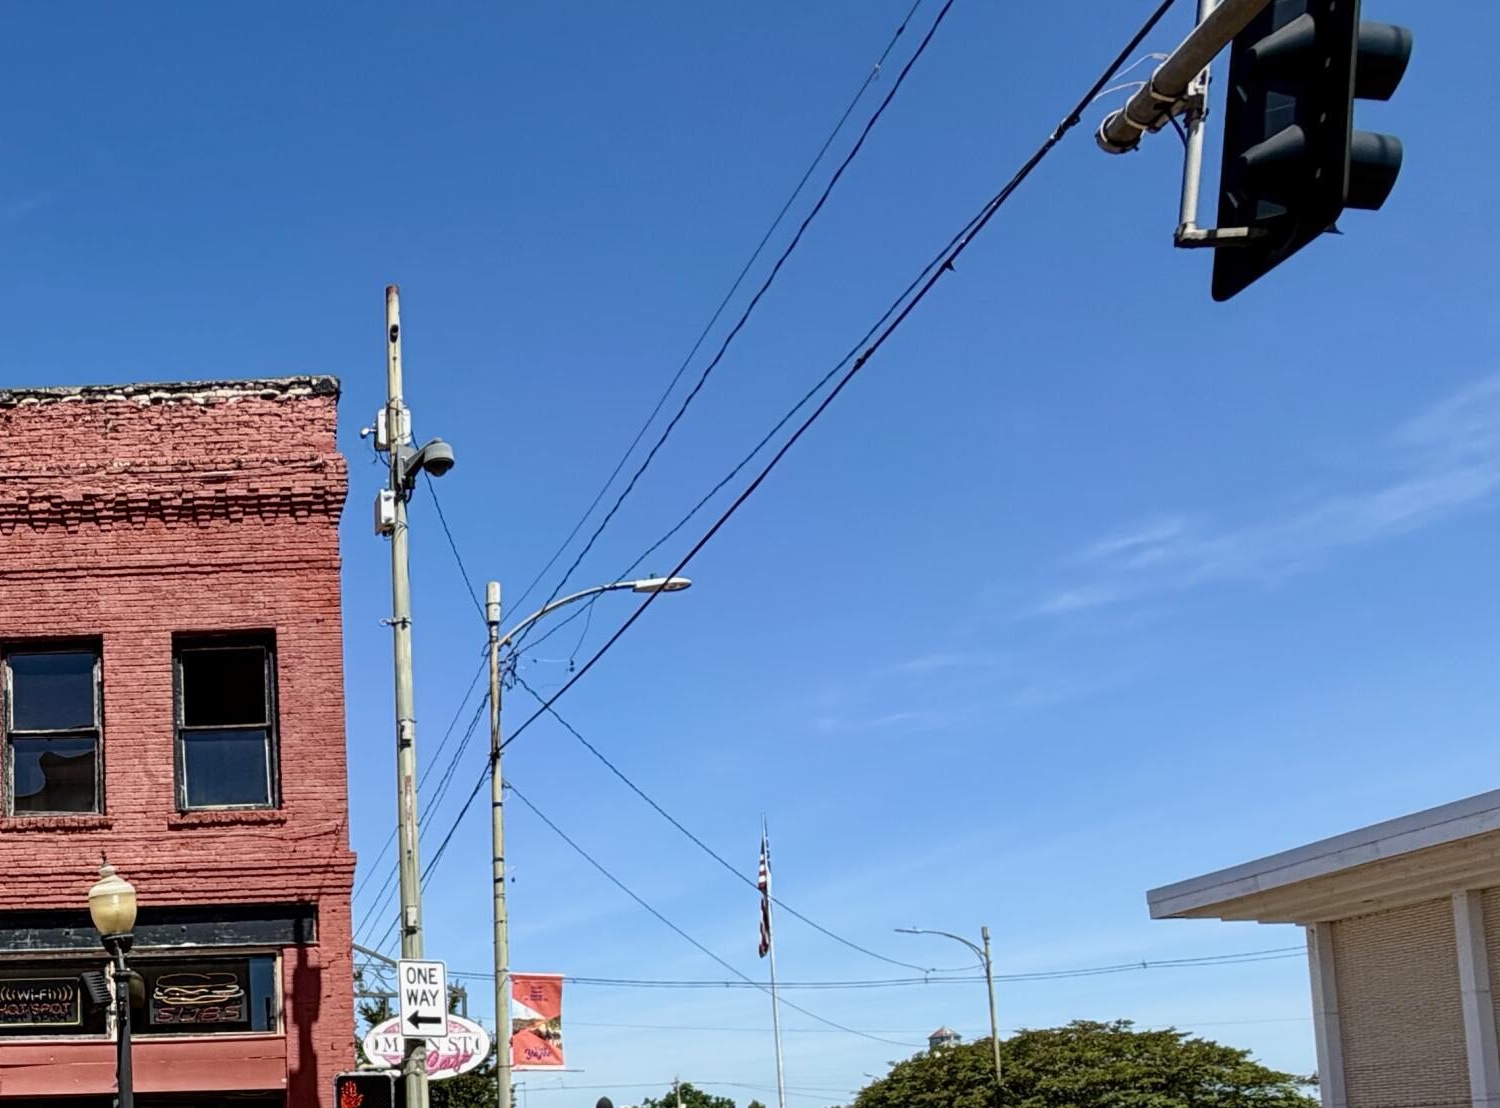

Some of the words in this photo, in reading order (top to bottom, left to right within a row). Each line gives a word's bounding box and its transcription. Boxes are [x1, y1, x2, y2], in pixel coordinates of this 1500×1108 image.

[406, 967, 438, 984] ONE
[406, 989, 439, 1007] WAY
[31, 1002, 71, 1015] SPOT
[156, 1005, 242, 1022] SUBS
[383, 1036, 440, 1053] MN
